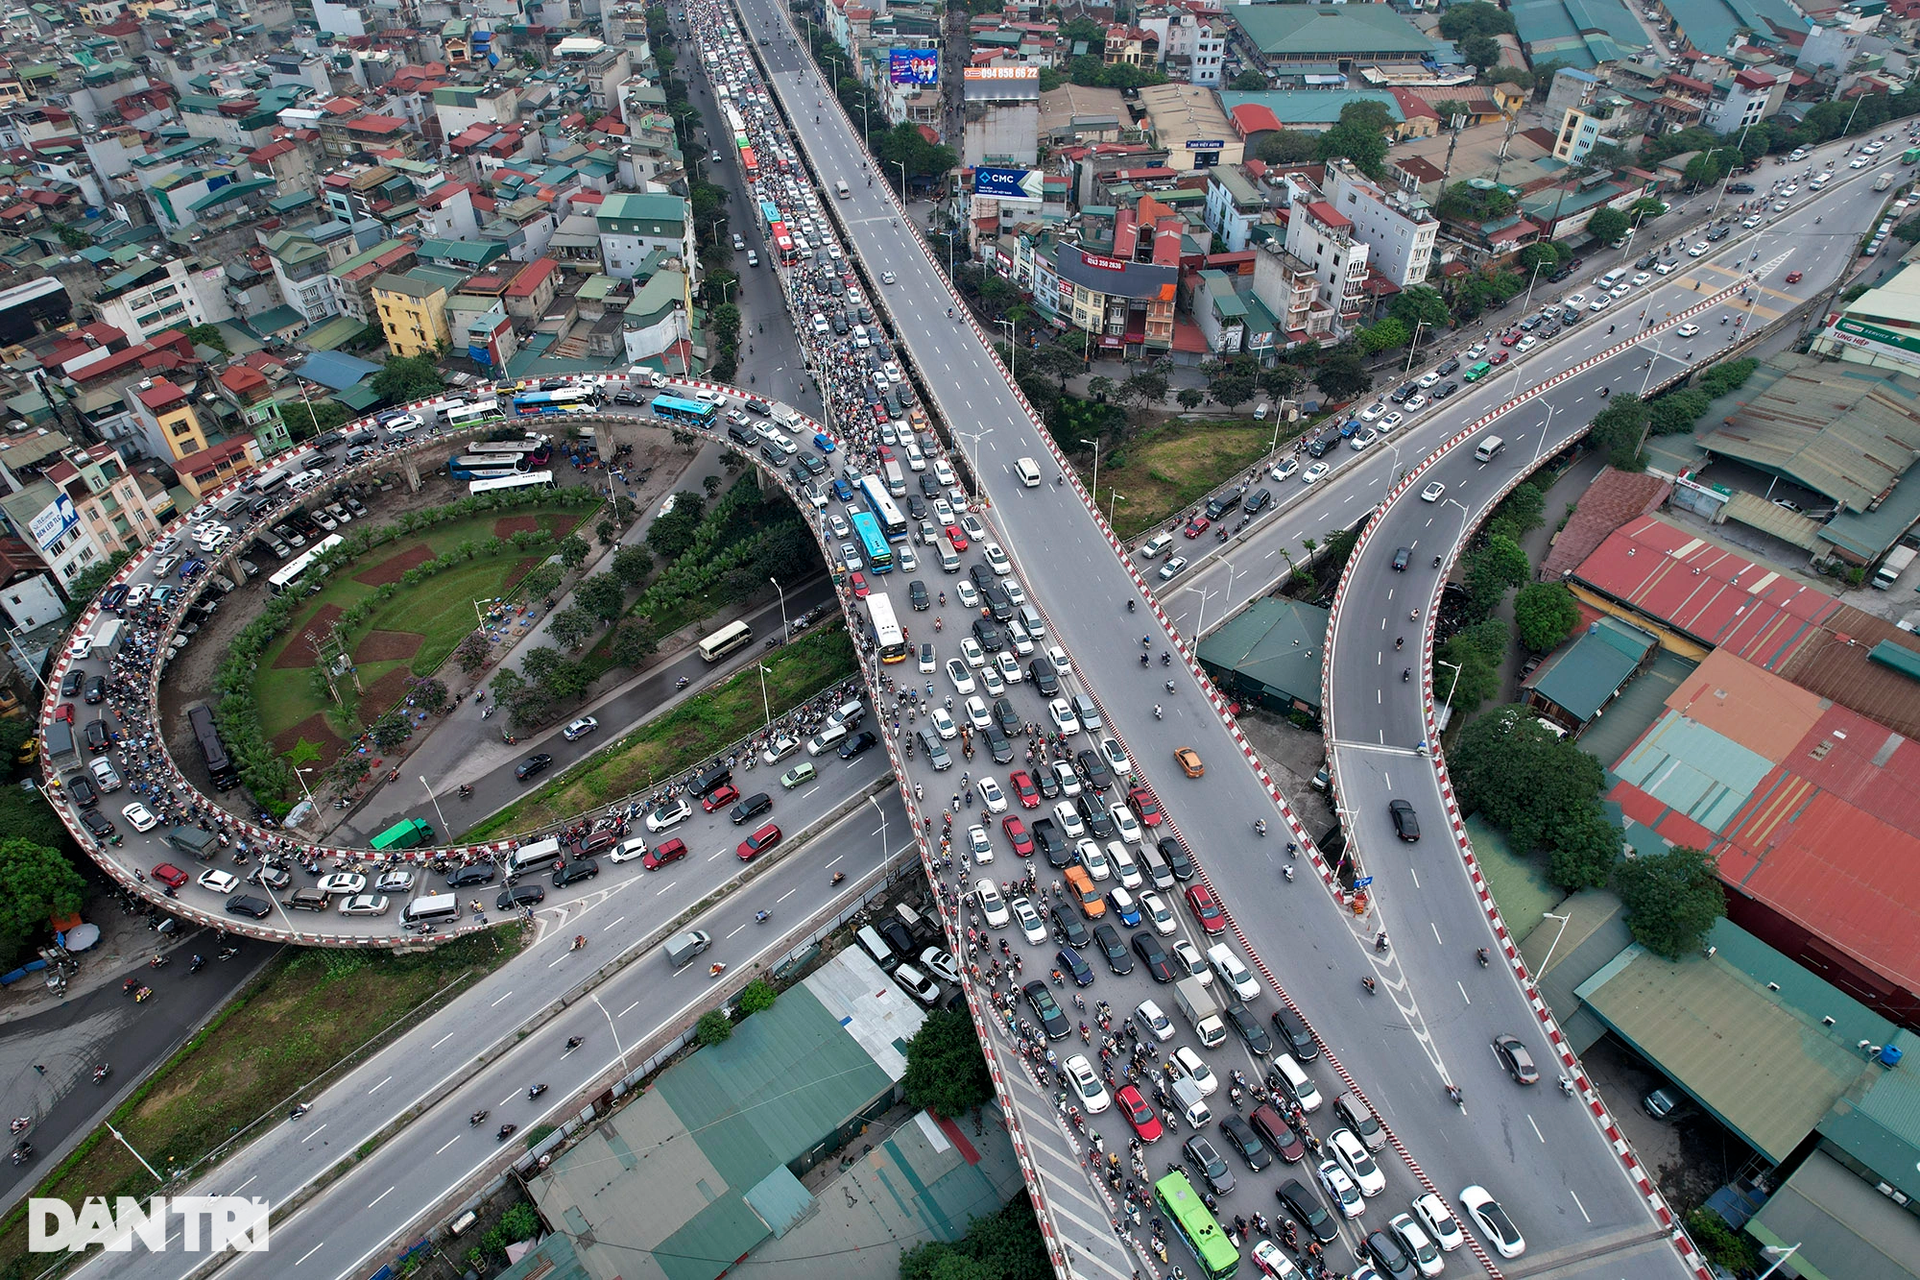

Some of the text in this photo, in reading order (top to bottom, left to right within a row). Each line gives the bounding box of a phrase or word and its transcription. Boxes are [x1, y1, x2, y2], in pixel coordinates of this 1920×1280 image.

[981, 68, 1038, 78] 094 858 66 22
[991, 174, 1014, 184] CMC
[1832, 330, 1870, 346] TÙNG HIỆP
[1864, 329, 1890, 339] SERVICE
[46, 521, 55, 531] LED
[52, 514, 62, 525] TLC
